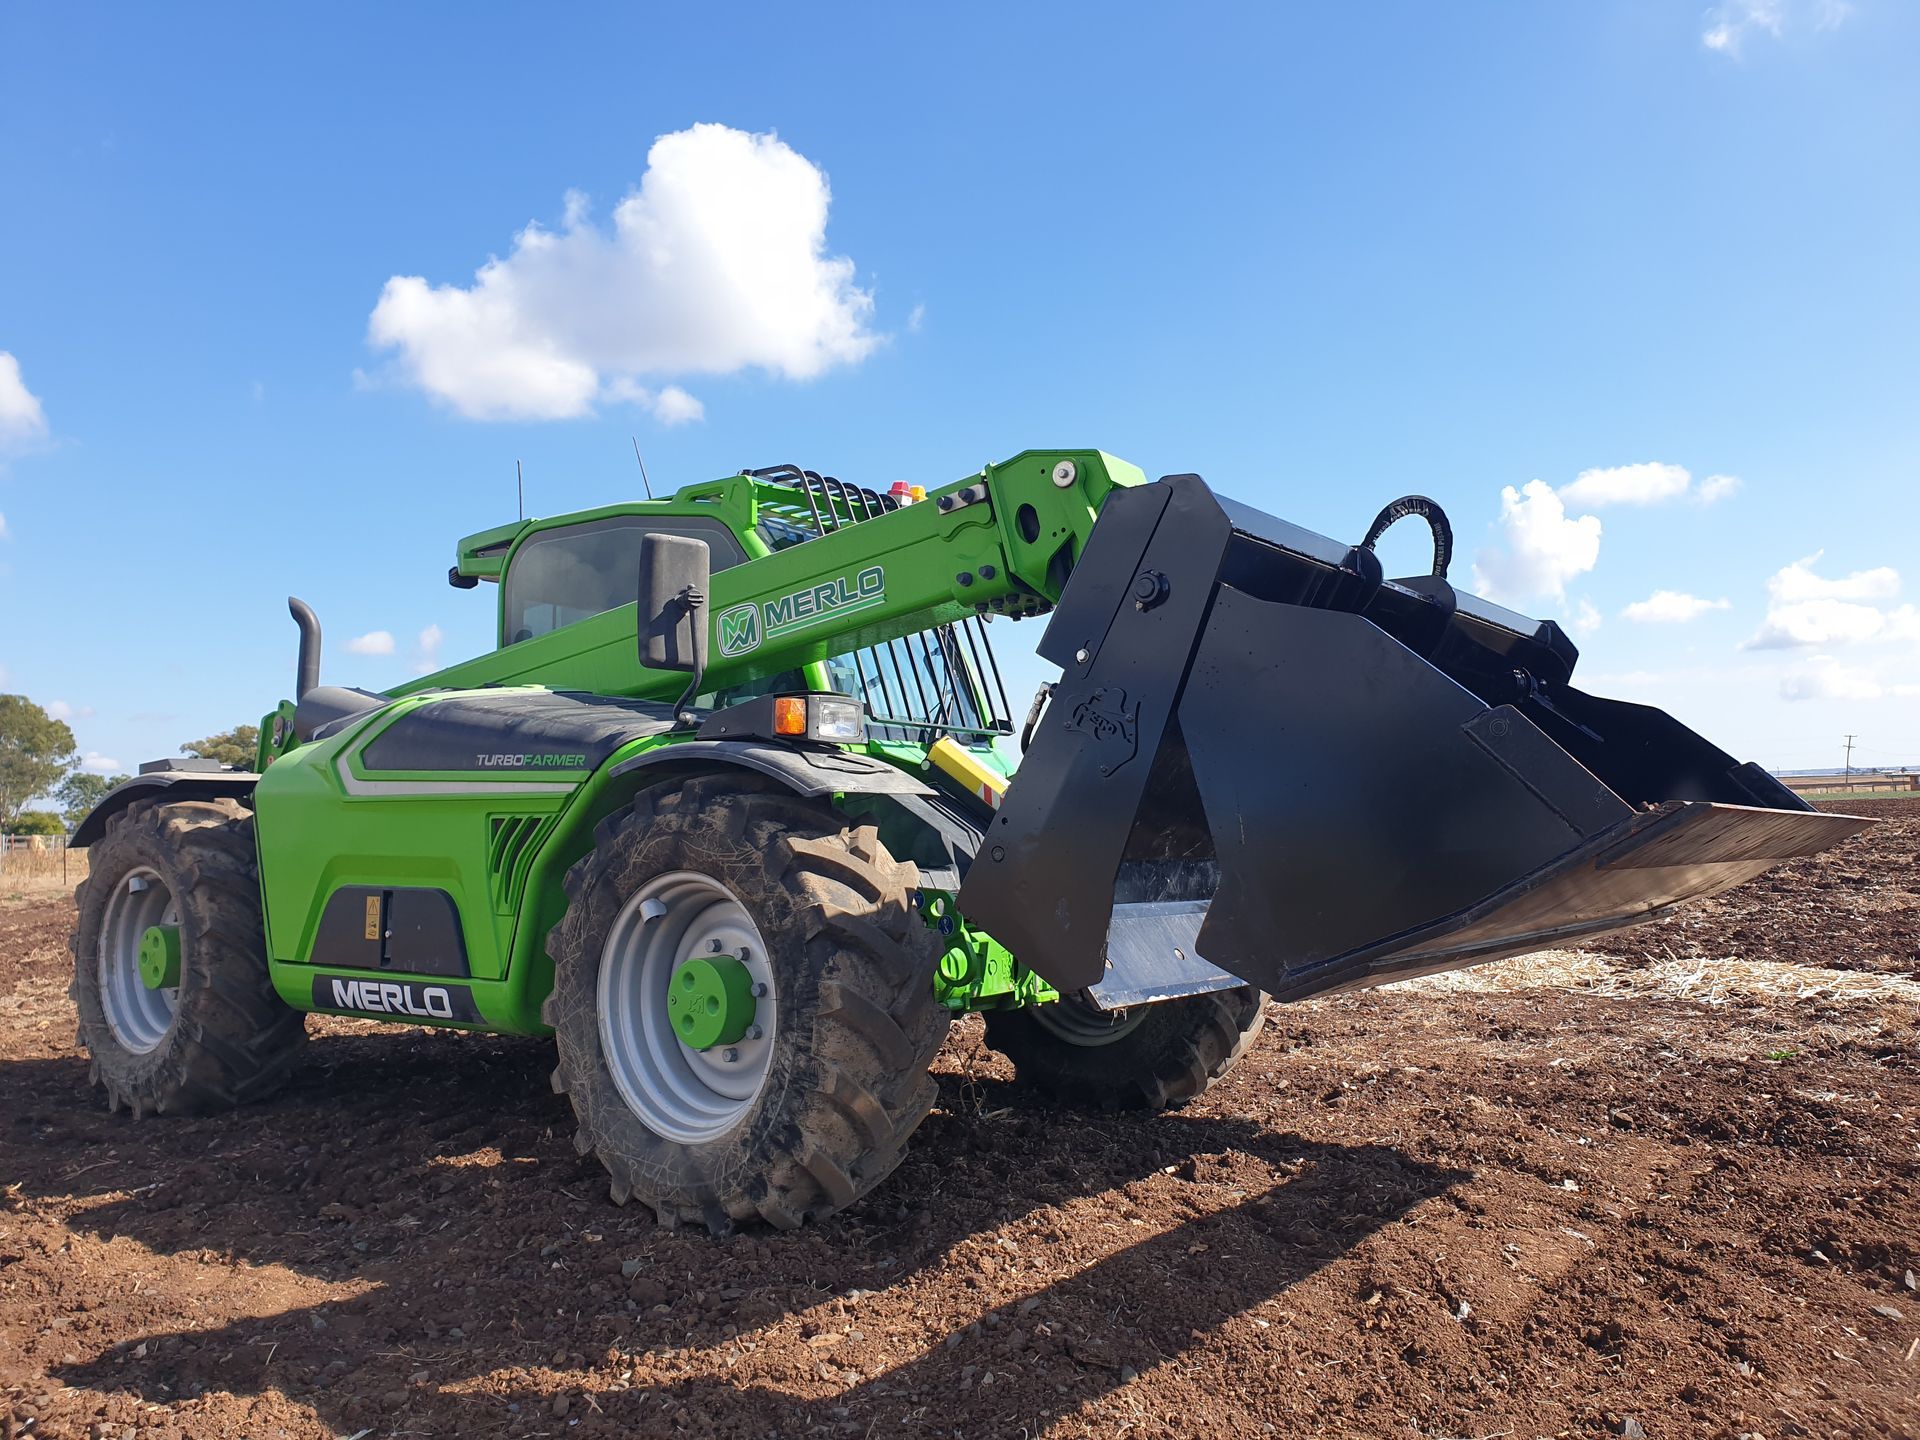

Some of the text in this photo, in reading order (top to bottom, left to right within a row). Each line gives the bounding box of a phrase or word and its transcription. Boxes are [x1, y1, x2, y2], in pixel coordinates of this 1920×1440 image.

[763, 565, 885, 629] MERLO
[476, 754, 586, 767] TURBOFARMER
[331, 979, 453, 1019] MERLO
